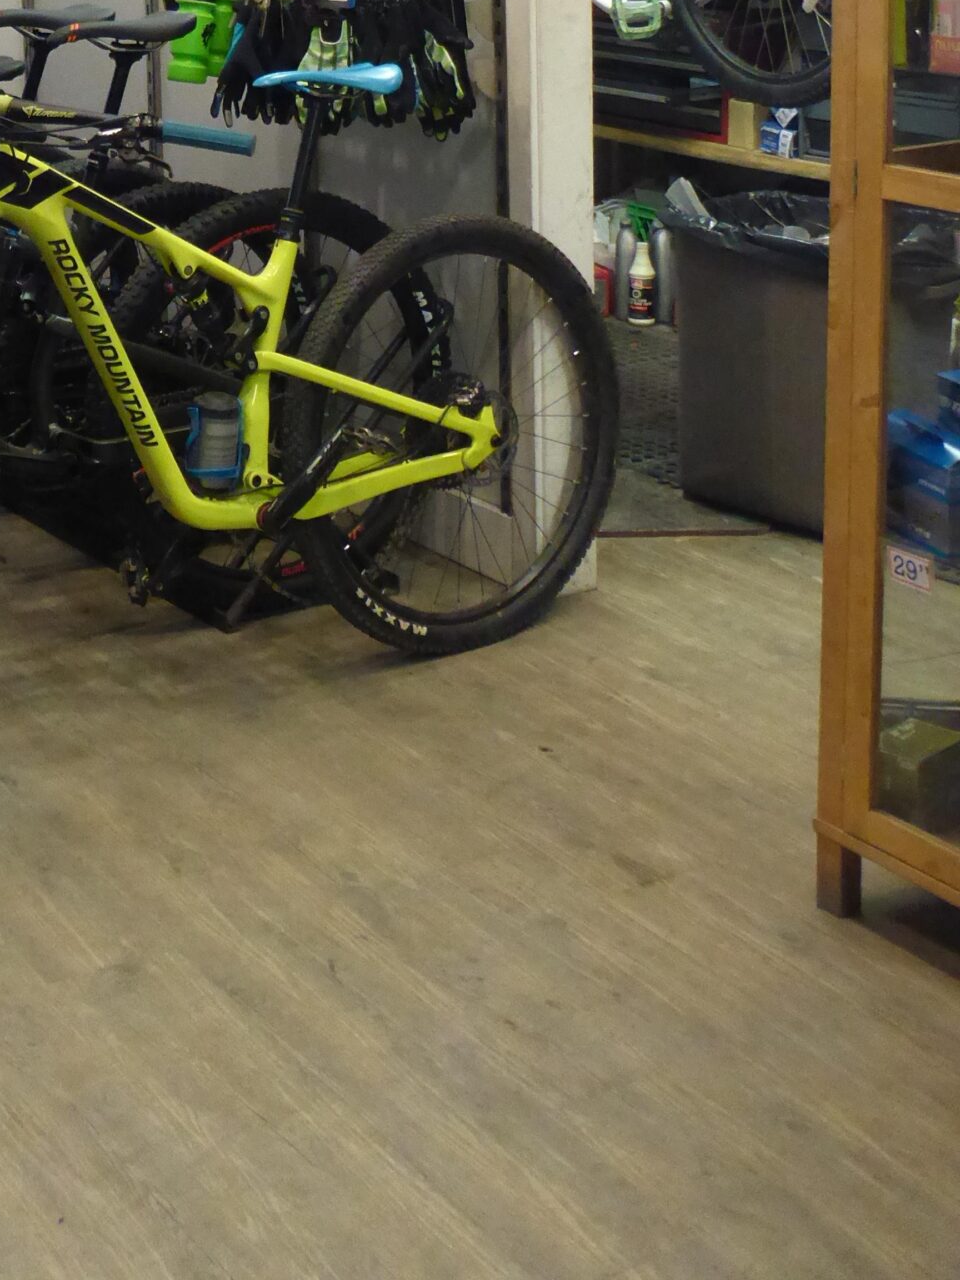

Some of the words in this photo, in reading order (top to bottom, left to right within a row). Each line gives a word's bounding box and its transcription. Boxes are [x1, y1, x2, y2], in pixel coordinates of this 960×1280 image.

[46, 238, 100, 318] ROCKY
[87, 324, 160, 449] MOUNTAIN
[355, 586, 428, 637] MAXXIS
